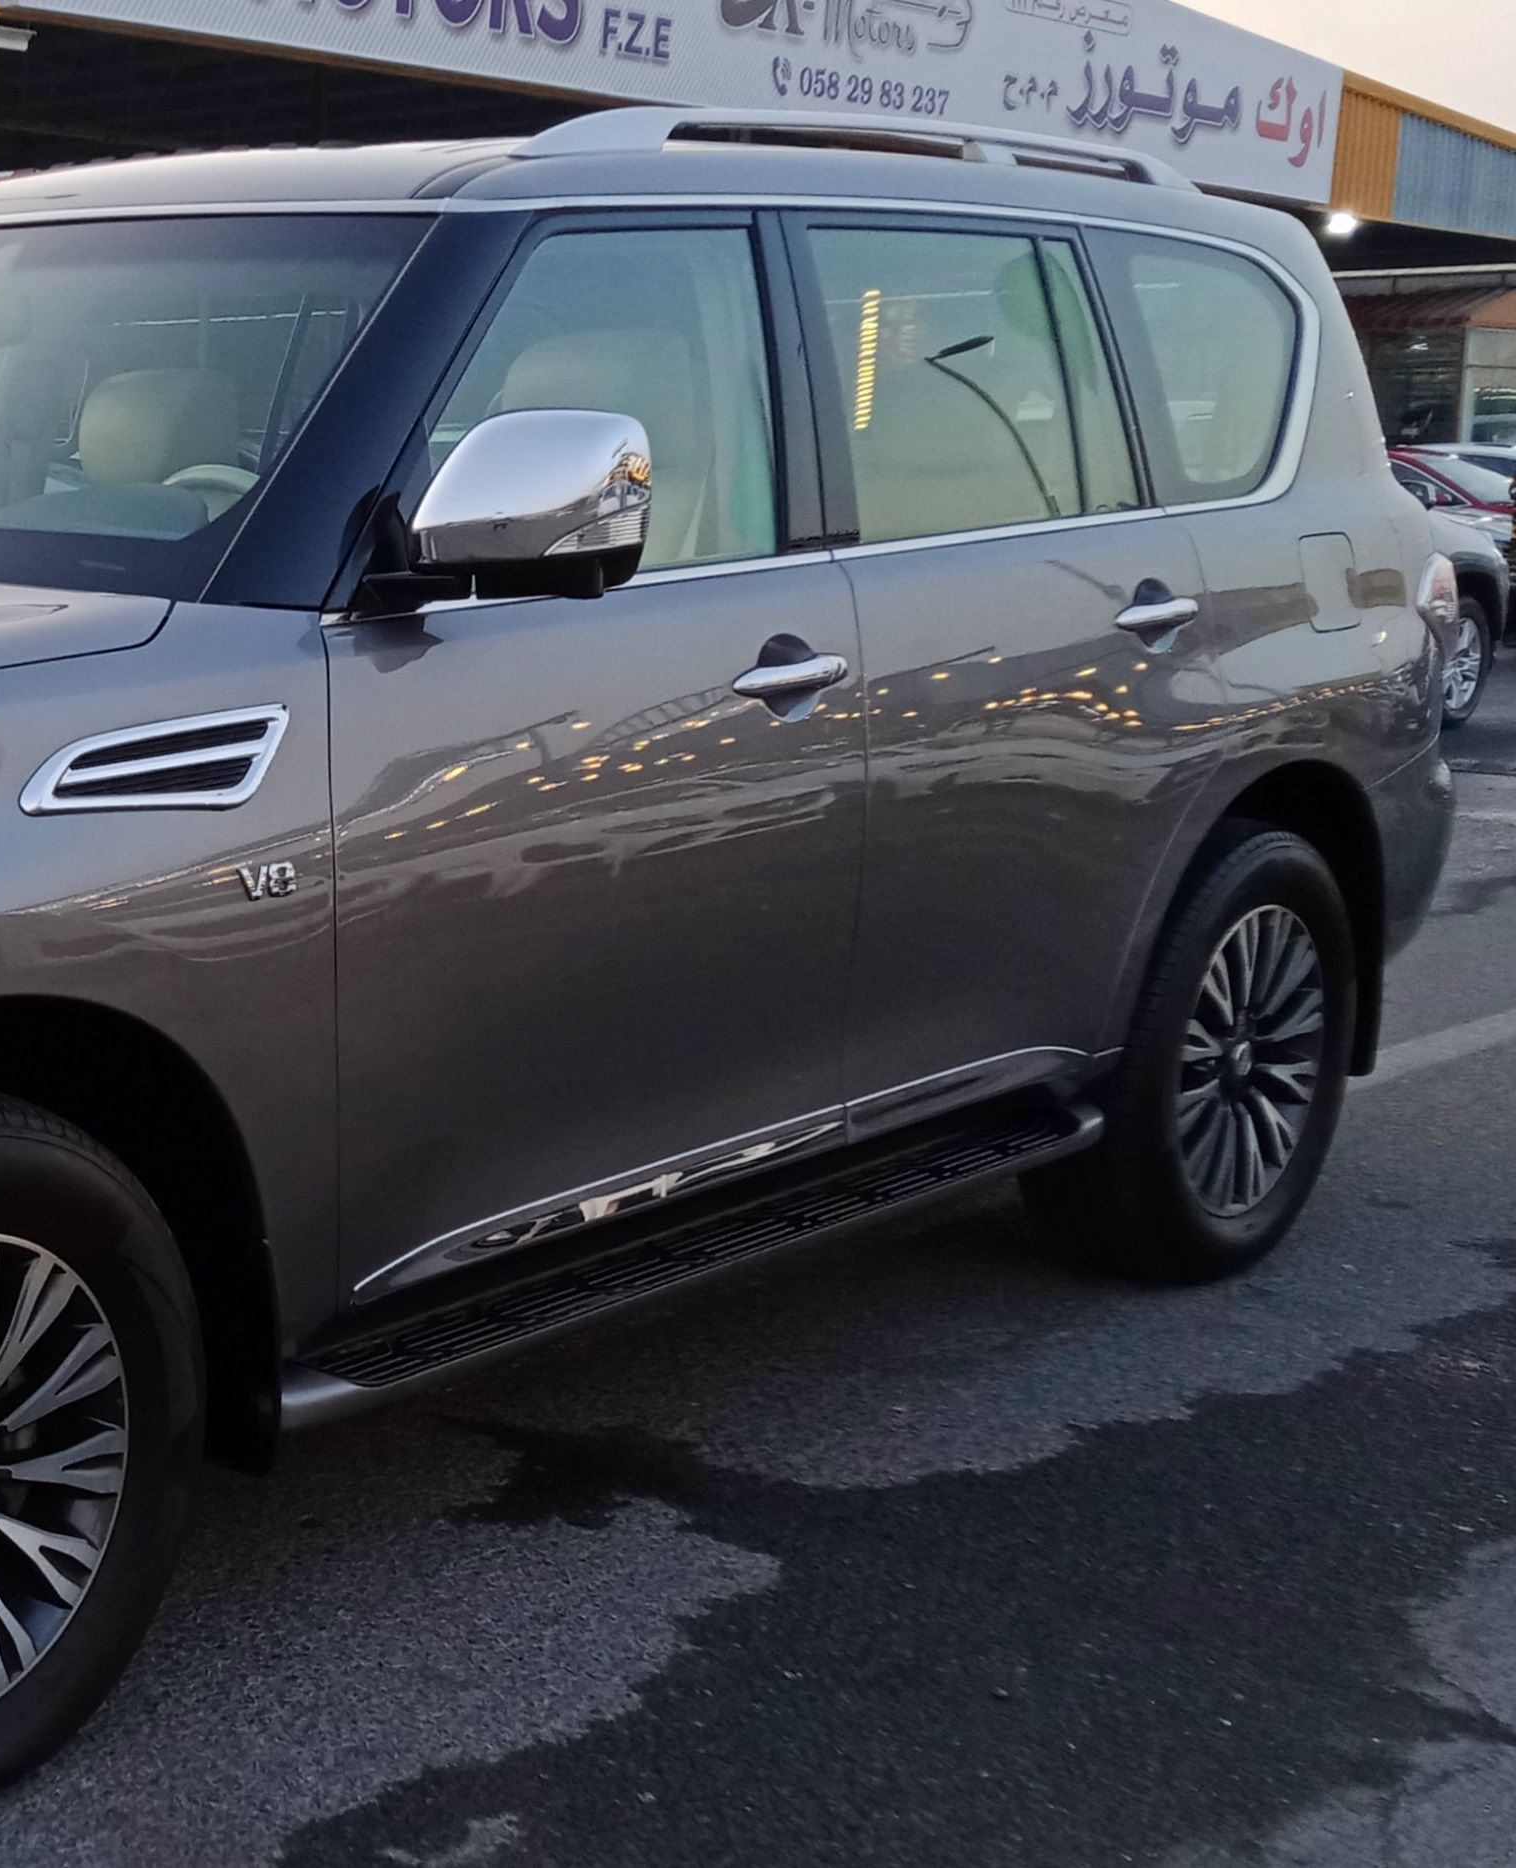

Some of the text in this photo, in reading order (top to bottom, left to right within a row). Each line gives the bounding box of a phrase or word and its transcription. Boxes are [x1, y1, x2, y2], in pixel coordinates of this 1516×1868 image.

[601, 8, 673, 59] F.Z.E
[799, 67, 951, 116] 058 29 83 237
[1066, 29, 1241, 143] موتورز
[236, 861, 297, 901] V8
